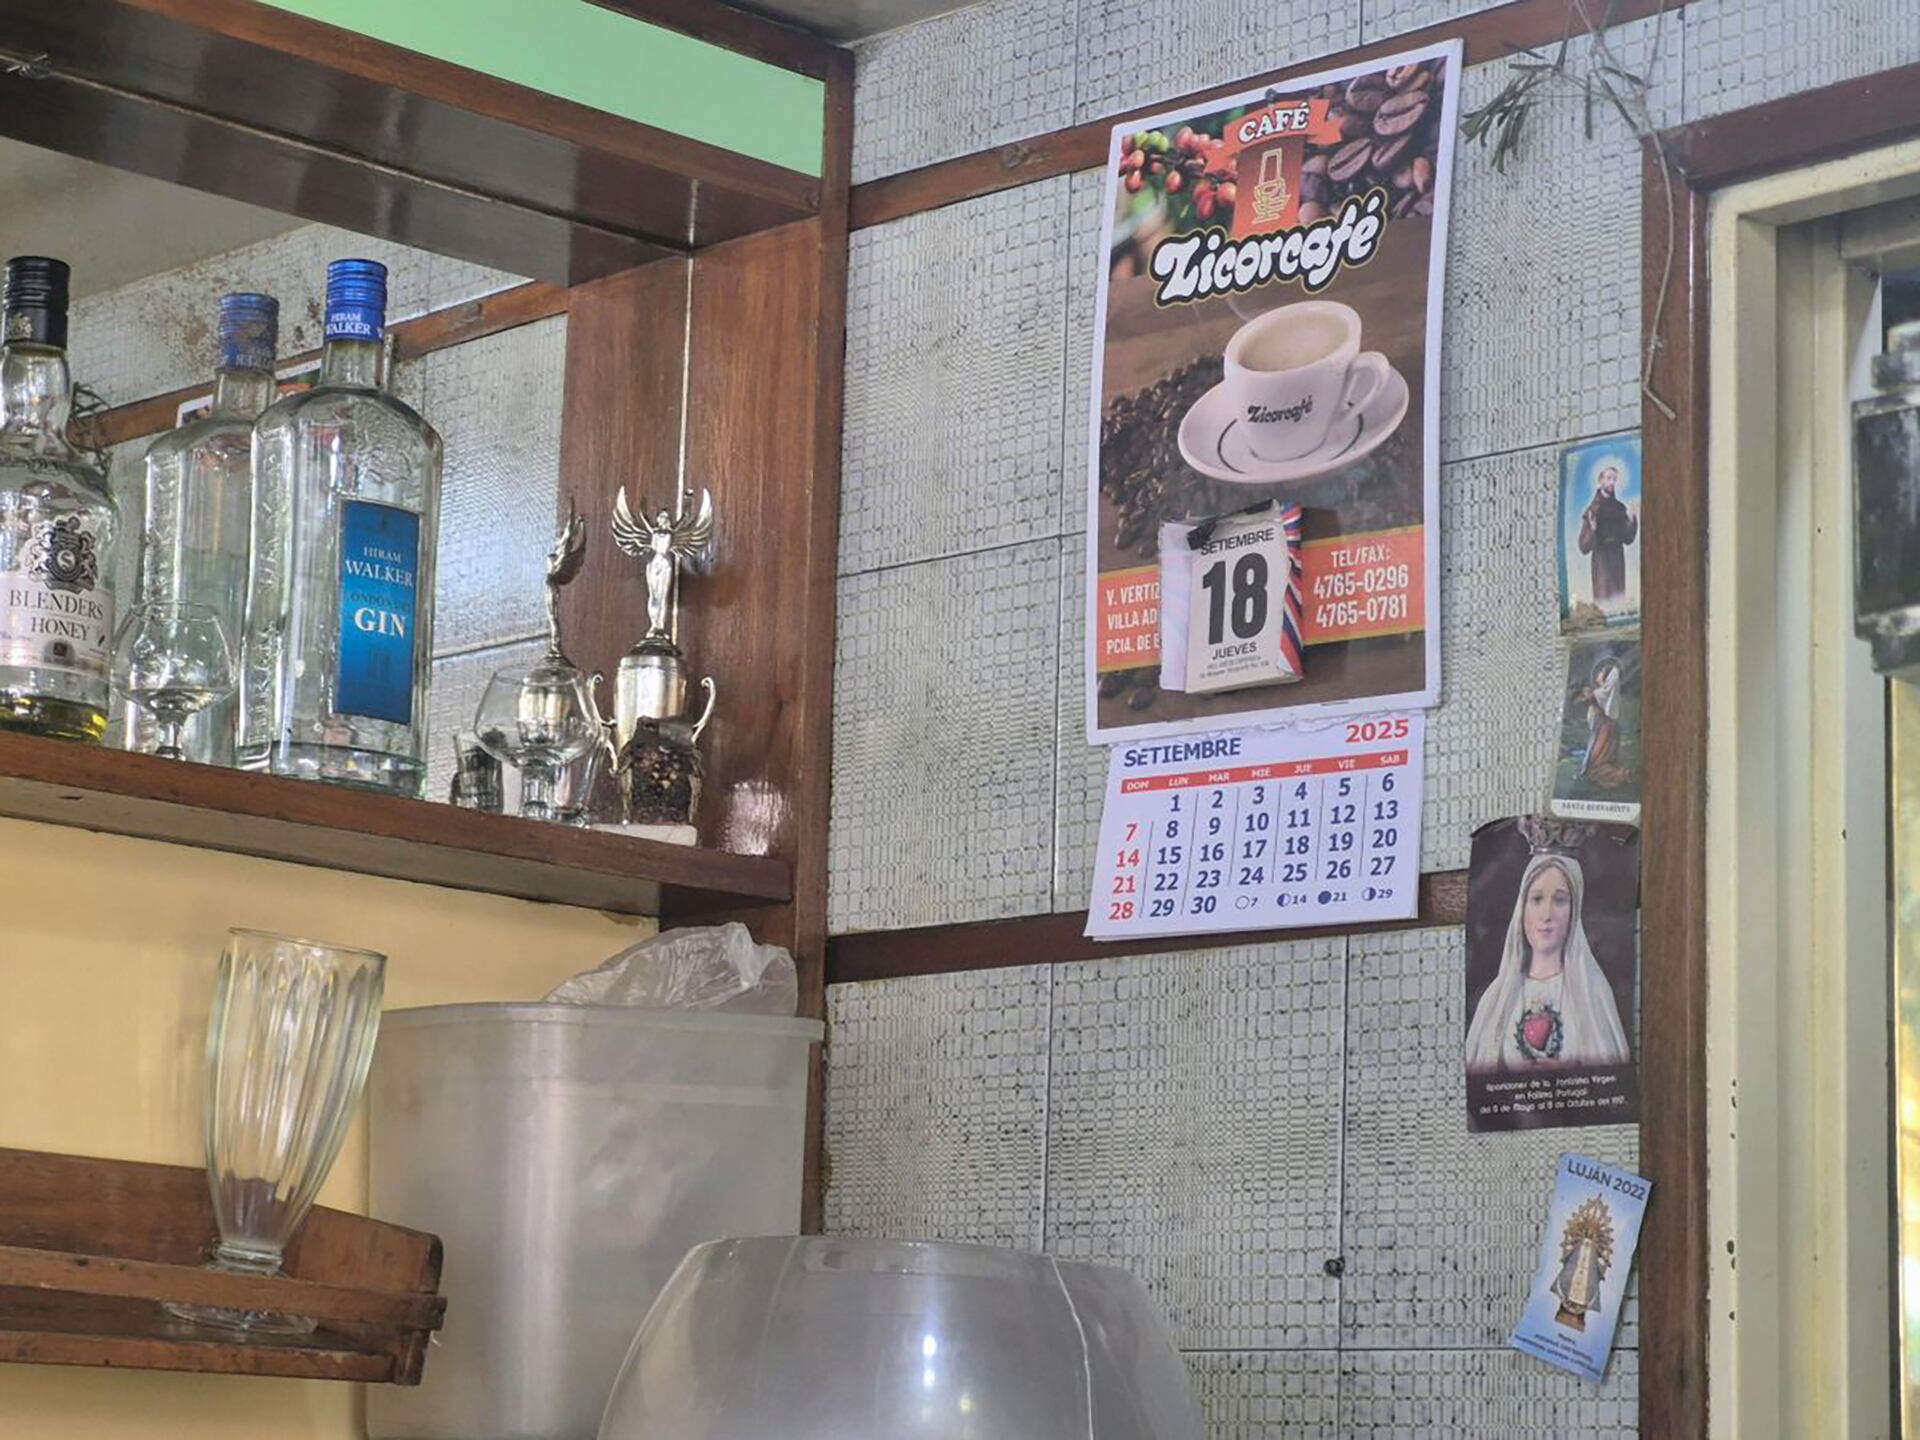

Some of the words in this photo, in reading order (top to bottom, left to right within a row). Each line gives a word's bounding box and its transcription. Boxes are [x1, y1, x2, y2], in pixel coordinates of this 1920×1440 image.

[1238, 103, 1310, 142] CAFÉ
[1153, 196, 1380, 301] Zicorcafé
[331, 312, 361, 323] HIRAM
[363, 545, 402, 563] HIRAM
[1200, 527, 1276, 557] SETIEMBRE
[1331, 544, 1391, 569] TEL/FAX:
[344, 558, 414, 589] WALKER
[1313, 563, 1409, 600] 4765-0296
[9, 588, 104, 621] BLENDERS
[1202, 552, 1269, 646] 18
[1315, 592, 1408, 629] 4765-0781
[31, 615, 91, 642] HONEY
[354, 607, 407, 640] GIN
[1107, 611, 1140, 631] VILLA
[1137, 633, 1151, 652] DE
[1211, 641, 1258, 661] JUEVES
[1123, 737, 1242, 768] SETIEMBRE
[1344, 718, 1410, 744] 2025
[1168, 777, 1189, 787] LUN
[1208, 773, 1230, 782] MAR
[1251, 768, 1271, 777] MIE
[1294, 764, 1312, 774] JUE
[1338, 760, 1355, 769] VIE
[1380, 755, 1400, 765] SAB
[1170, 794, 1181, 812] 1
[1211, 790, 1223, 809] 2
[1252, 786, 1264, 805] 3
[1295, 781, 1308, 800] 4
[1338, 777, 1351, 796] 5
[1382, 773, 1395, 792] 6
[1125, 823, 1138, 842] 7
[1166, 820, 1179, 838] 8
[1209, 817, 1221, 836] 9
[1245, 812, 1269, 832] 10
[1287, 808, 1311, 828] 11
[1330, 804, 1356, 824] 12
[1374, 800, 1399, 820] 13
[1116, 850, 1140, 868] 14
[1157, 847, 1182, 865] 15
[1200, 843, 1224, 862] 16
[1242, 839, 1267, 859] 17
[1285, 835, 1310, 855] 18
[1328, 831, 1354, 852] 19
[1372, 828, 1398, 848] 20
[1112, 876, 1136, 894] 21
[1154, 873, 1179, 891] 22
[1196, 870, 1221, 888] 23
[1239, 866, 1264, 885] 24
[1282, 862, 1308, 882] 25
[1326, 859, 1351, 879] 26
[1370, 856, 1396, 876] 27
[1108, 901, 1134, 920] 28
[1150, 899, 1175, 917] 29
[1190, 895, 1217, 914] 30
[1250, 898, 1258, 908] 7
[1293, 894, 1307, 905] 14
[1333, 891, 1347, 902] 21
[1378, 889, 1393, 899] 29
[1567, 1158, 1612, 1188] LUJÁN
[1612, 1177, 1647, 1201] 2022
